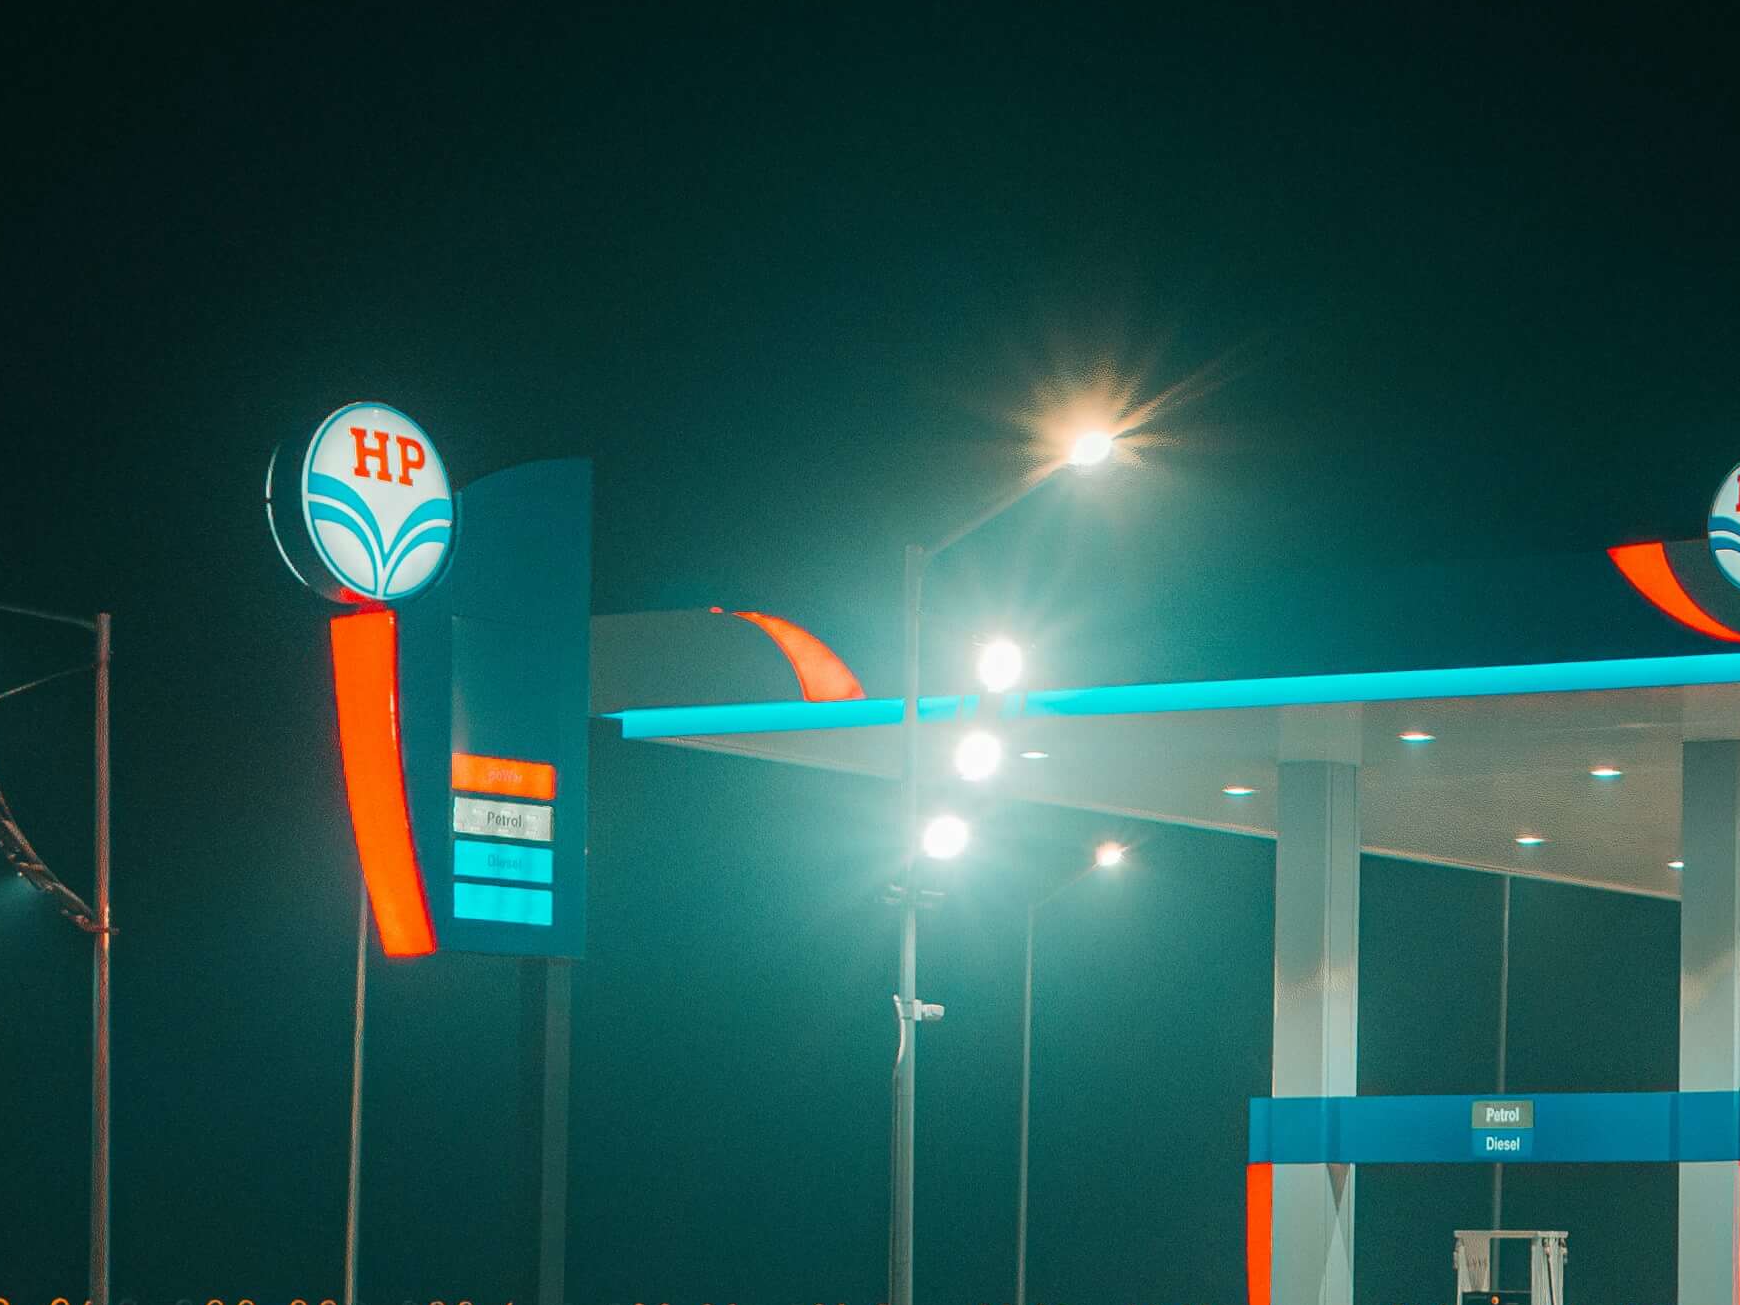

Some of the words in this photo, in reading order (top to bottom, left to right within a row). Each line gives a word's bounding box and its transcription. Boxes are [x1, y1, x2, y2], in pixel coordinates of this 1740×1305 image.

[349, 426, 426, 487] HP
[487, 811, 522, 828] Petrol
[1486, 1107, 1519, 1122] Petrol
[1486, 1136, 1520, 1151] Diesel
